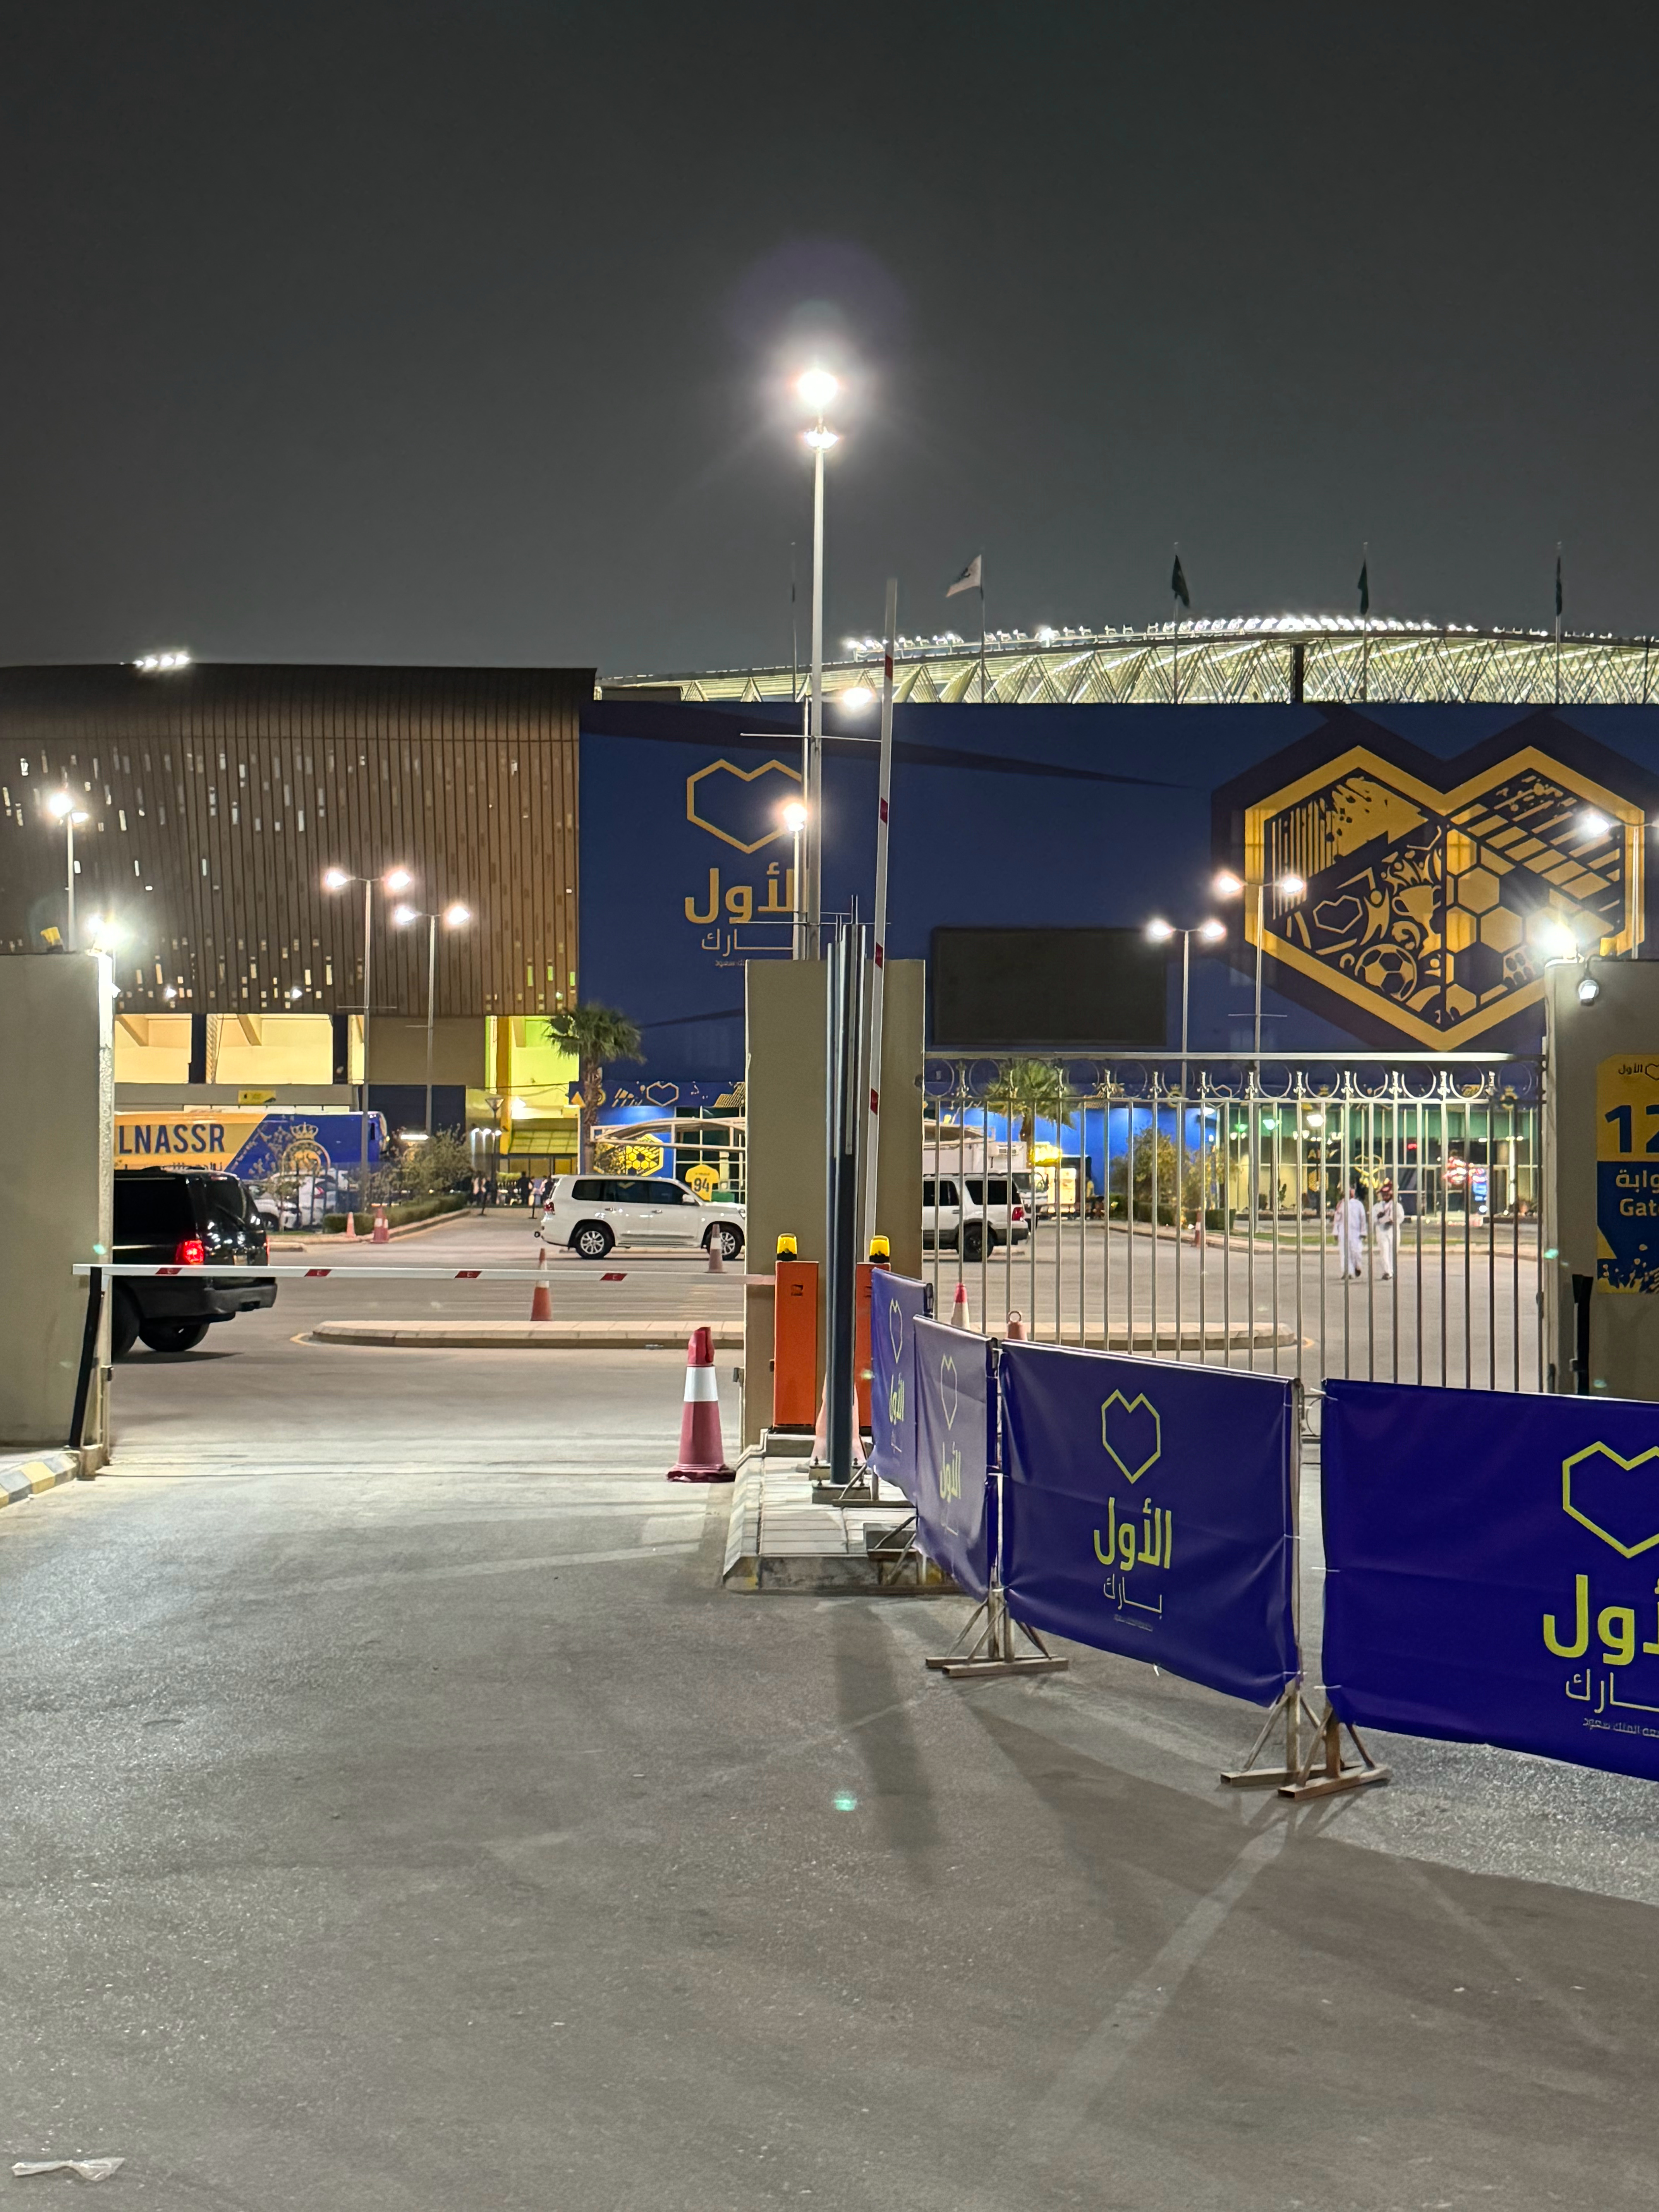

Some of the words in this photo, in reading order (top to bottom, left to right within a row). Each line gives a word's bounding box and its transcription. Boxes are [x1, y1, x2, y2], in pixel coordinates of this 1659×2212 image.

[685, 862, 795, 924] لأول
[701, 928, 793, 957] ارك
[119, 1124, 225, 1154] LNASSR
[694, 1178, 709, 1192] 94
[1616, 1169, 1659, 1193] وابة
[1620, 1198, 1659, 1216] Gat
[1094, 1497, 1172, 1571] الأول
[1566, 1668, 1659, 1714] ارك
